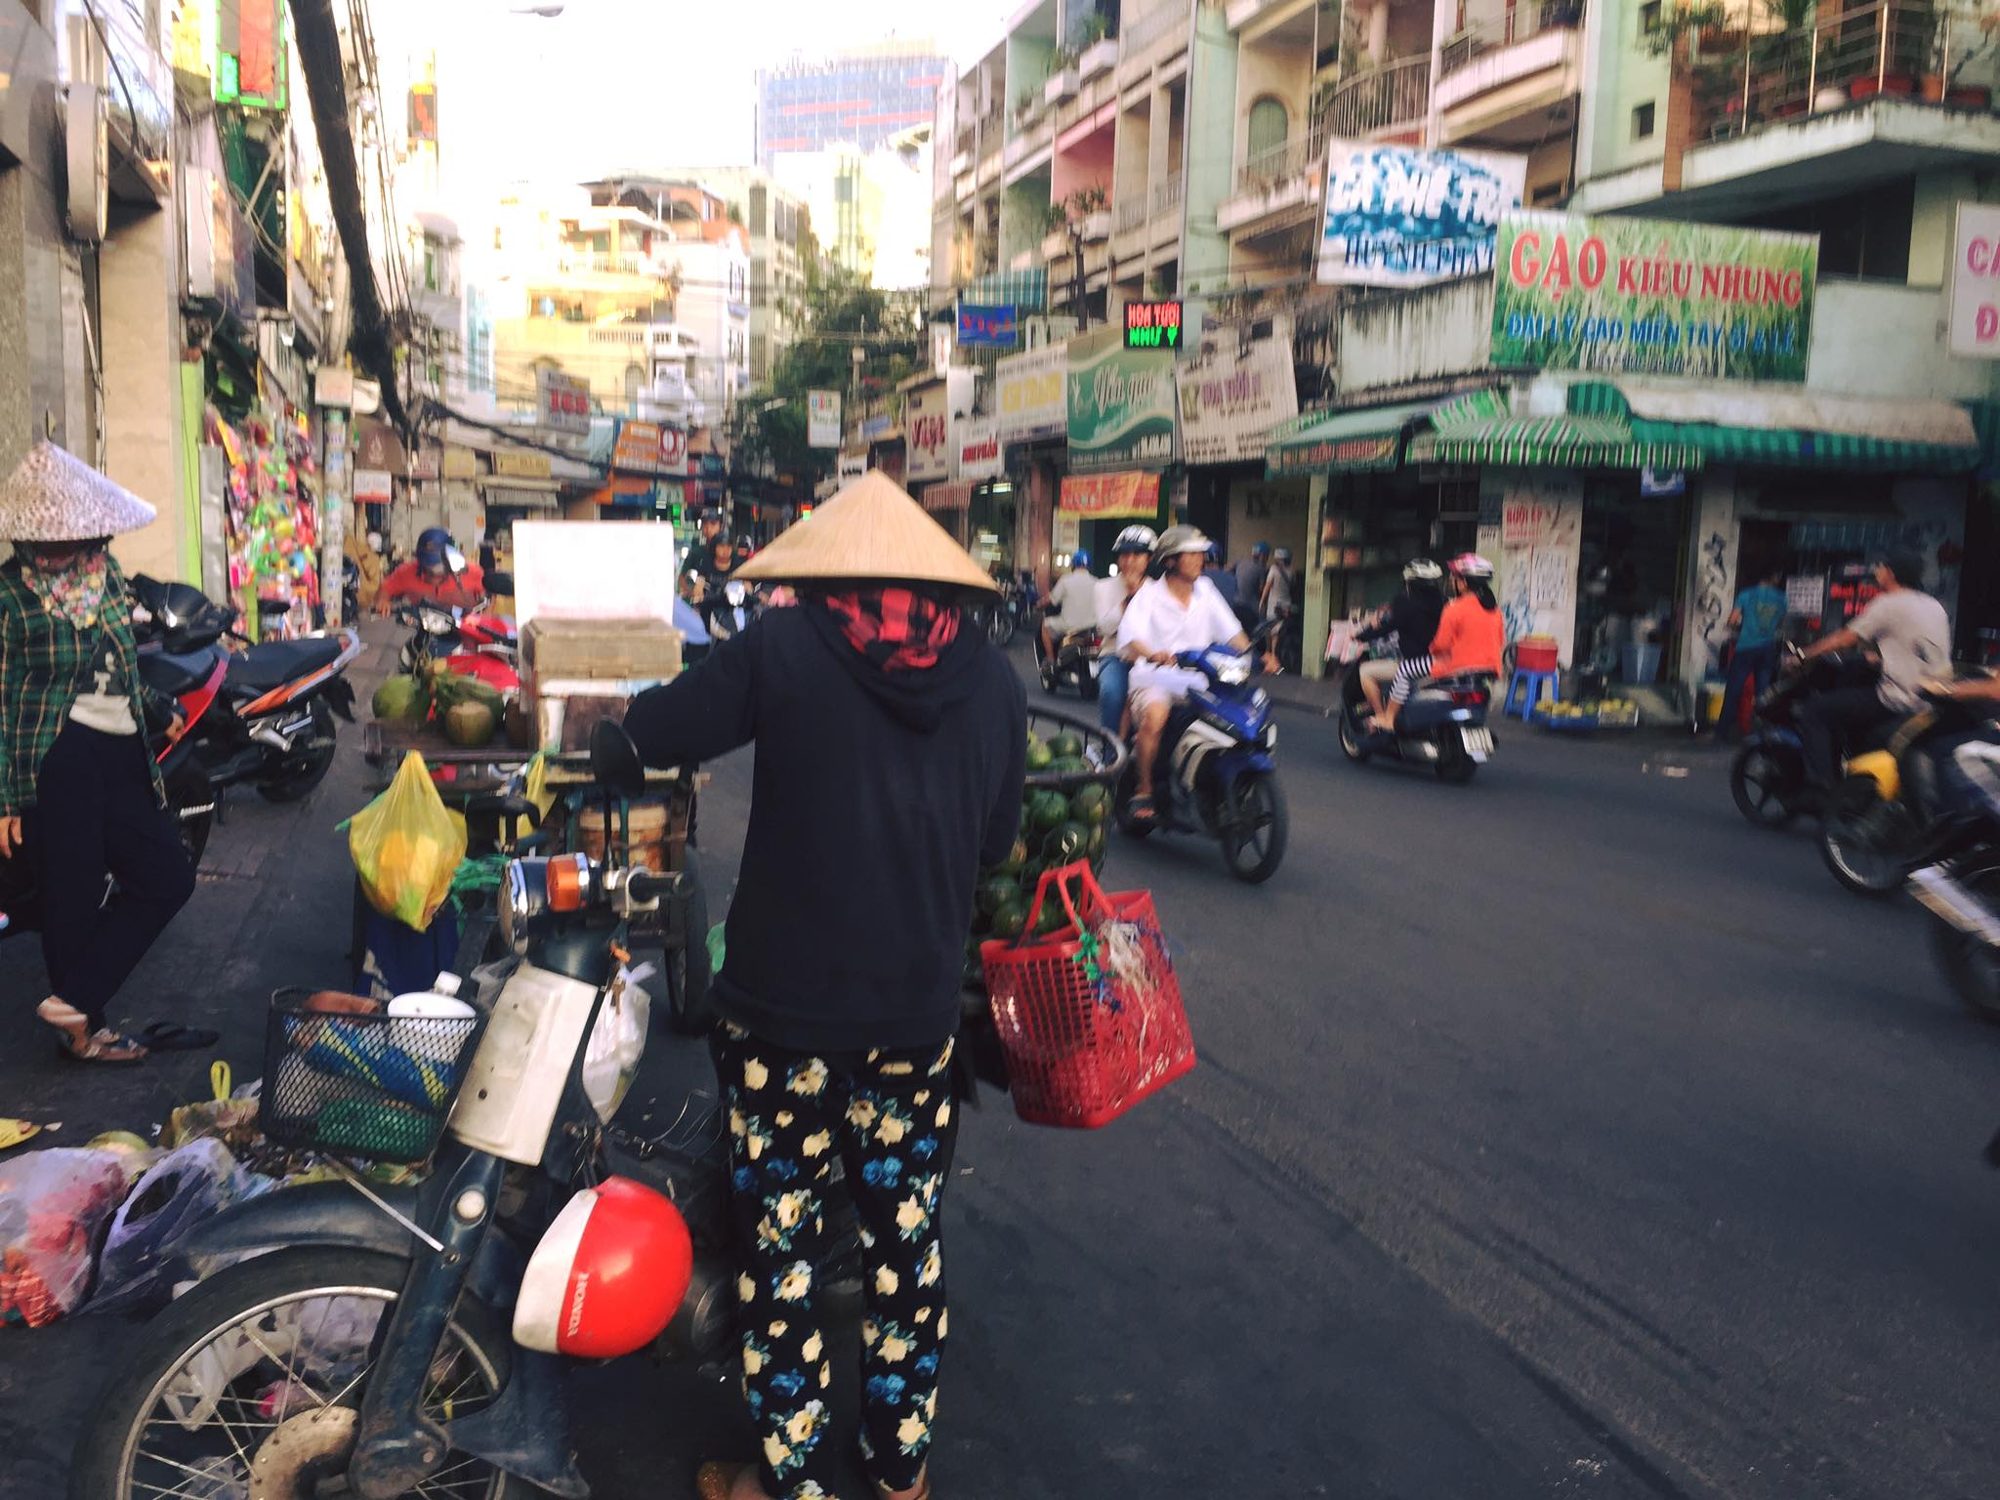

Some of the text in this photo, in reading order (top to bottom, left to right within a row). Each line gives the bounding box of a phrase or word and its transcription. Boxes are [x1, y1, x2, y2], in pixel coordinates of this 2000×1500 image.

[1510, 231, 1607, 301] GẠO
[1701, 262, 1803, 308] NHUNG
[1128, 302, 1180, 327] HOA TƯƠI
[1129, 326, 1162, 347] NHƯ
[567, 1272, 590, 1338] HONDA
